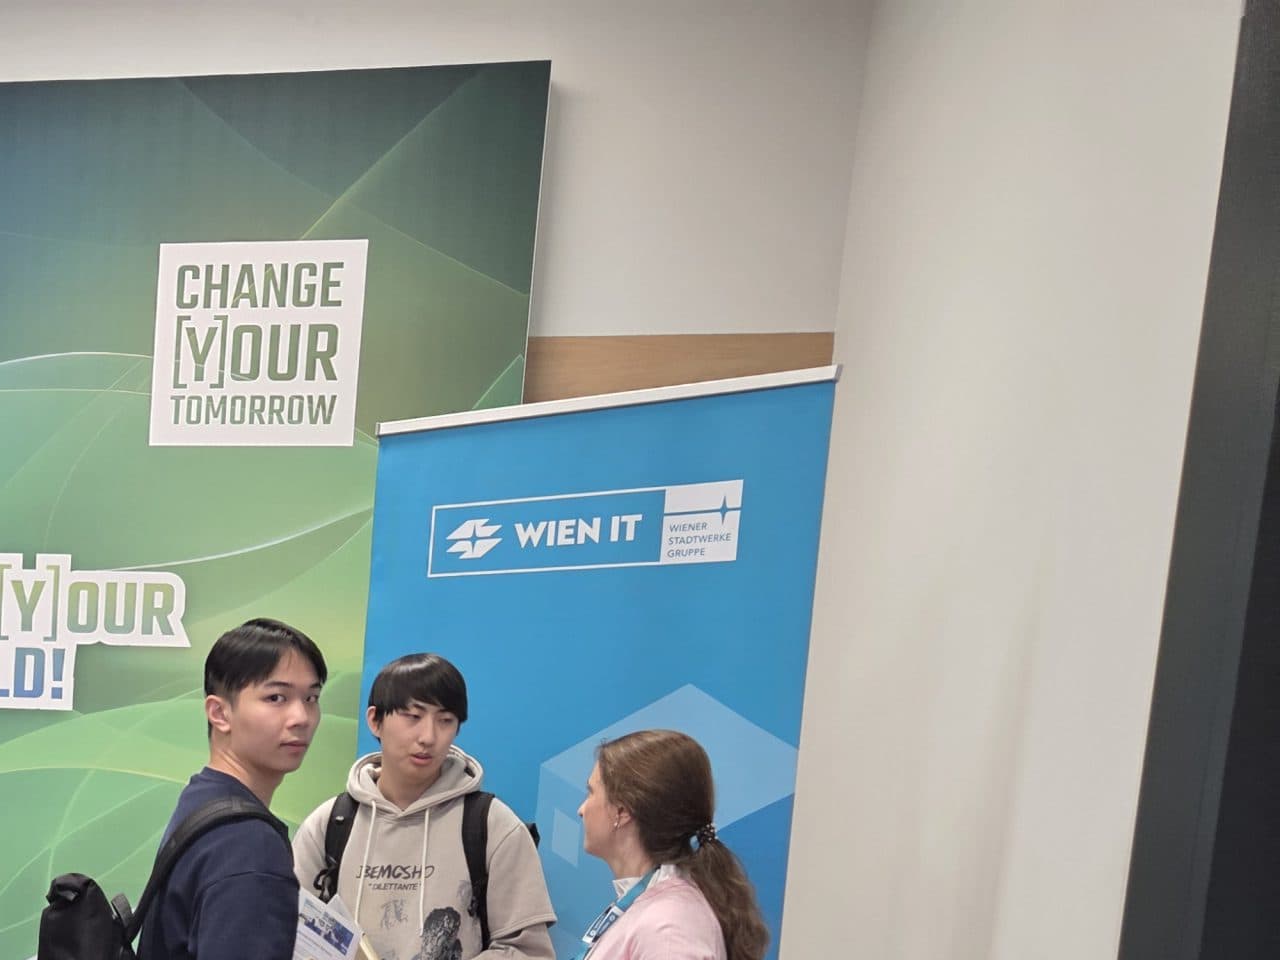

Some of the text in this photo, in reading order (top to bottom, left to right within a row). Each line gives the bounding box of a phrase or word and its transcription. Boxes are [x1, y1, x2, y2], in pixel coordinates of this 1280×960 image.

[175, 262, 344, 309] CHANGE
[173, 315, 339, 389] [Y]OUR
[170, 394, 338, 425] TOMORROW
[514, 514, 643, 548] WIEN IT
[668, 532, 732, 545] STADTWERKE
[669, 522, 708, 533] WIENER
[667, 547, 706, 558] GRUPPE
